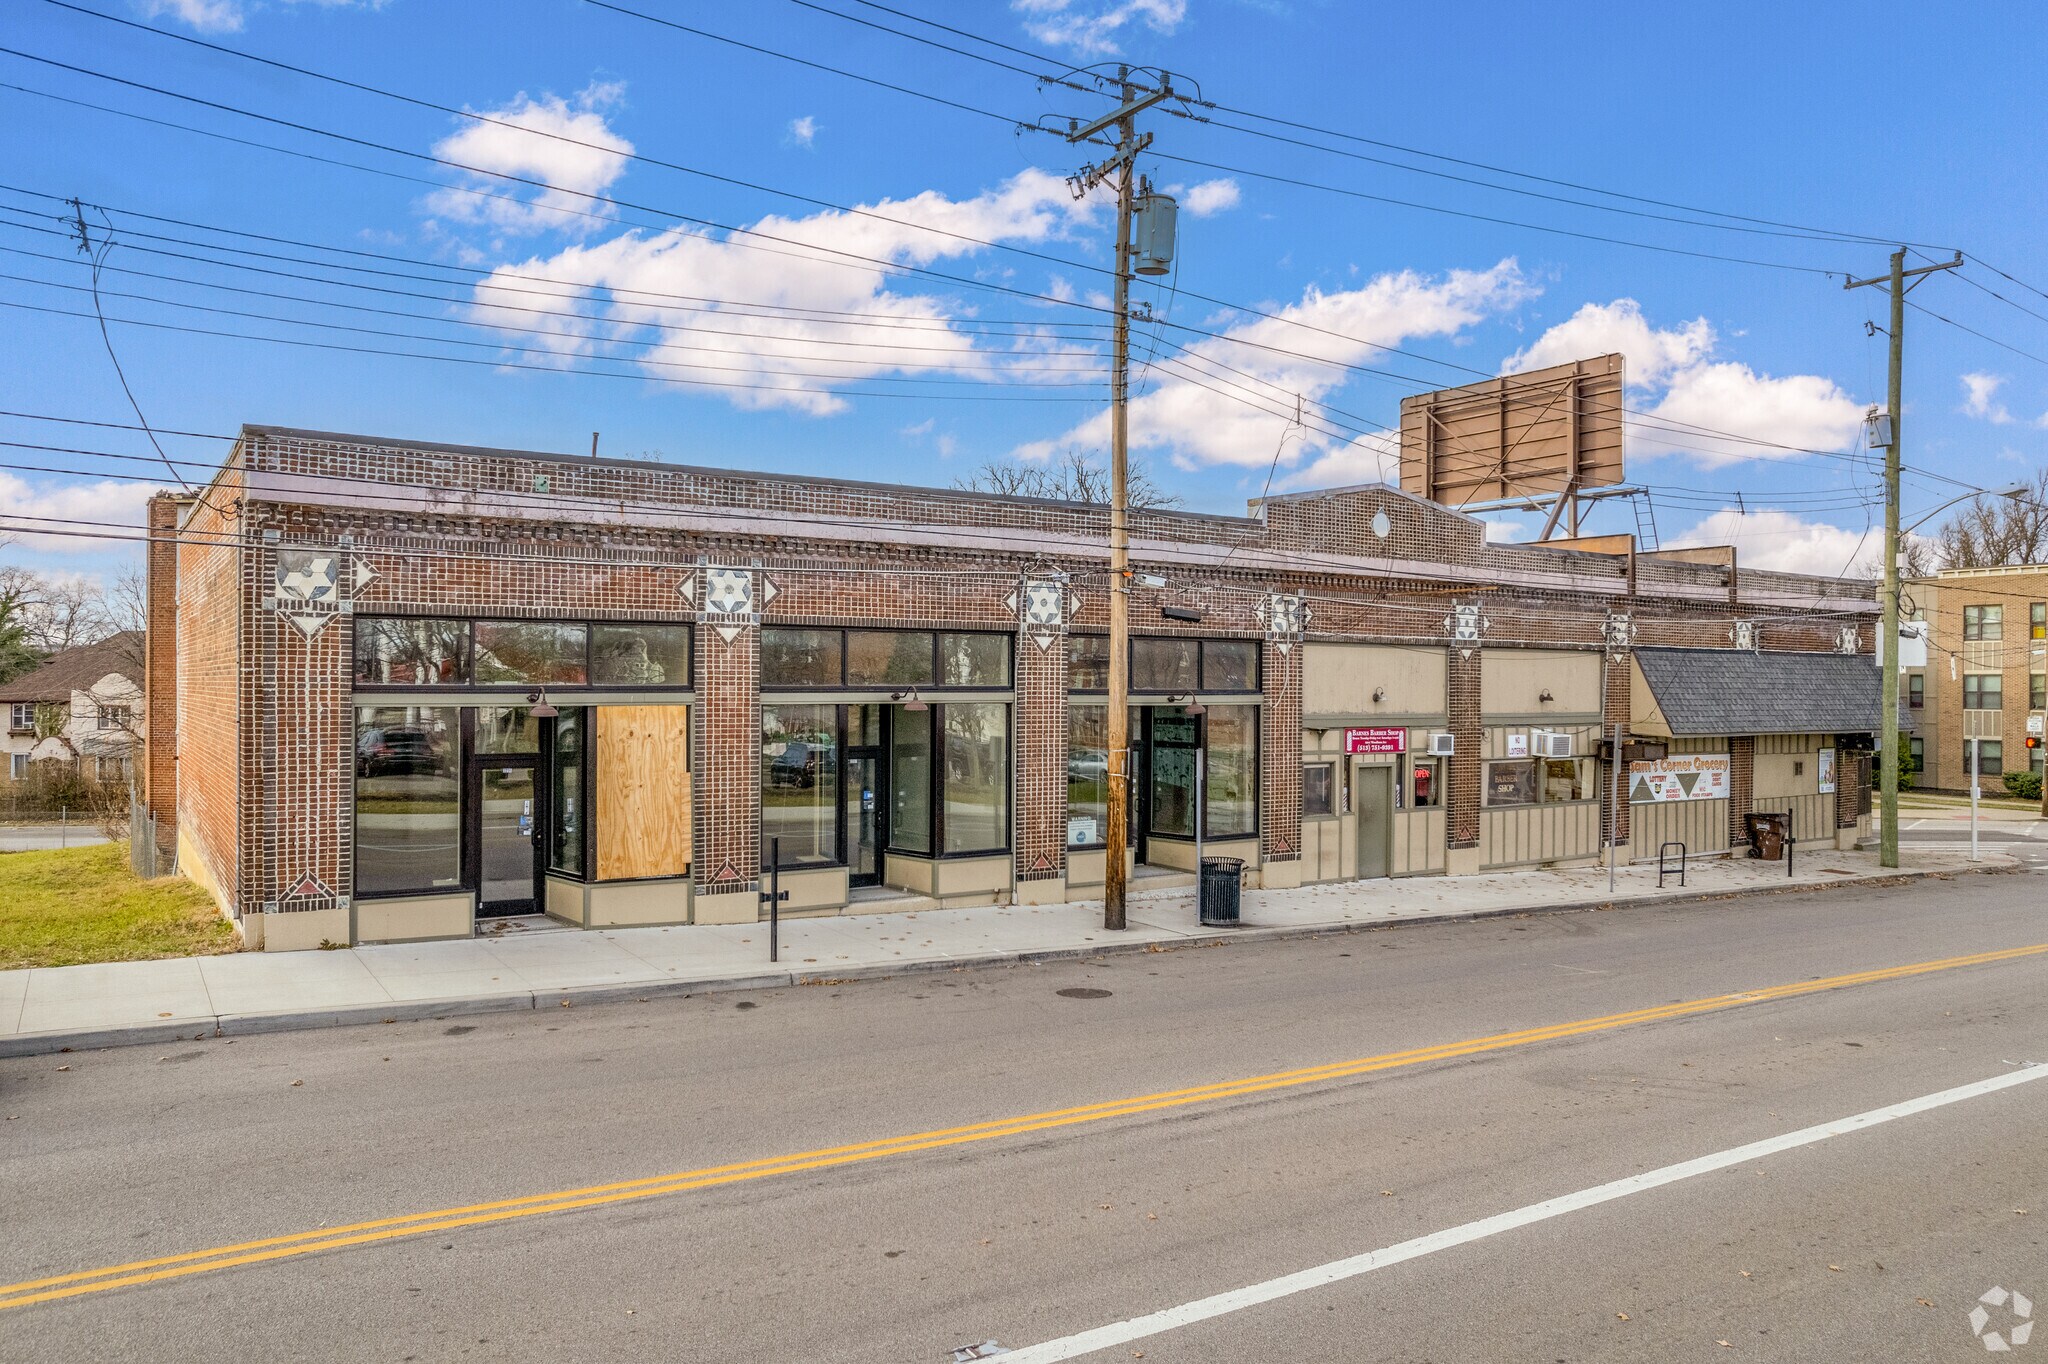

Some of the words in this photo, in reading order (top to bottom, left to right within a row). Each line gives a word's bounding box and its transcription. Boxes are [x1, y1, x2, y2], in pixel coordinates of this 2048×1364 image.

[1660, 758, 1692, 772] Corner
[1693, 757, 1728, 772] Grocery
[1415, 769, 1431, 778] OPEN
[1649, 775, 1667, 783] LOTTERY
[1498, 784, 1515, 793] SHOP
